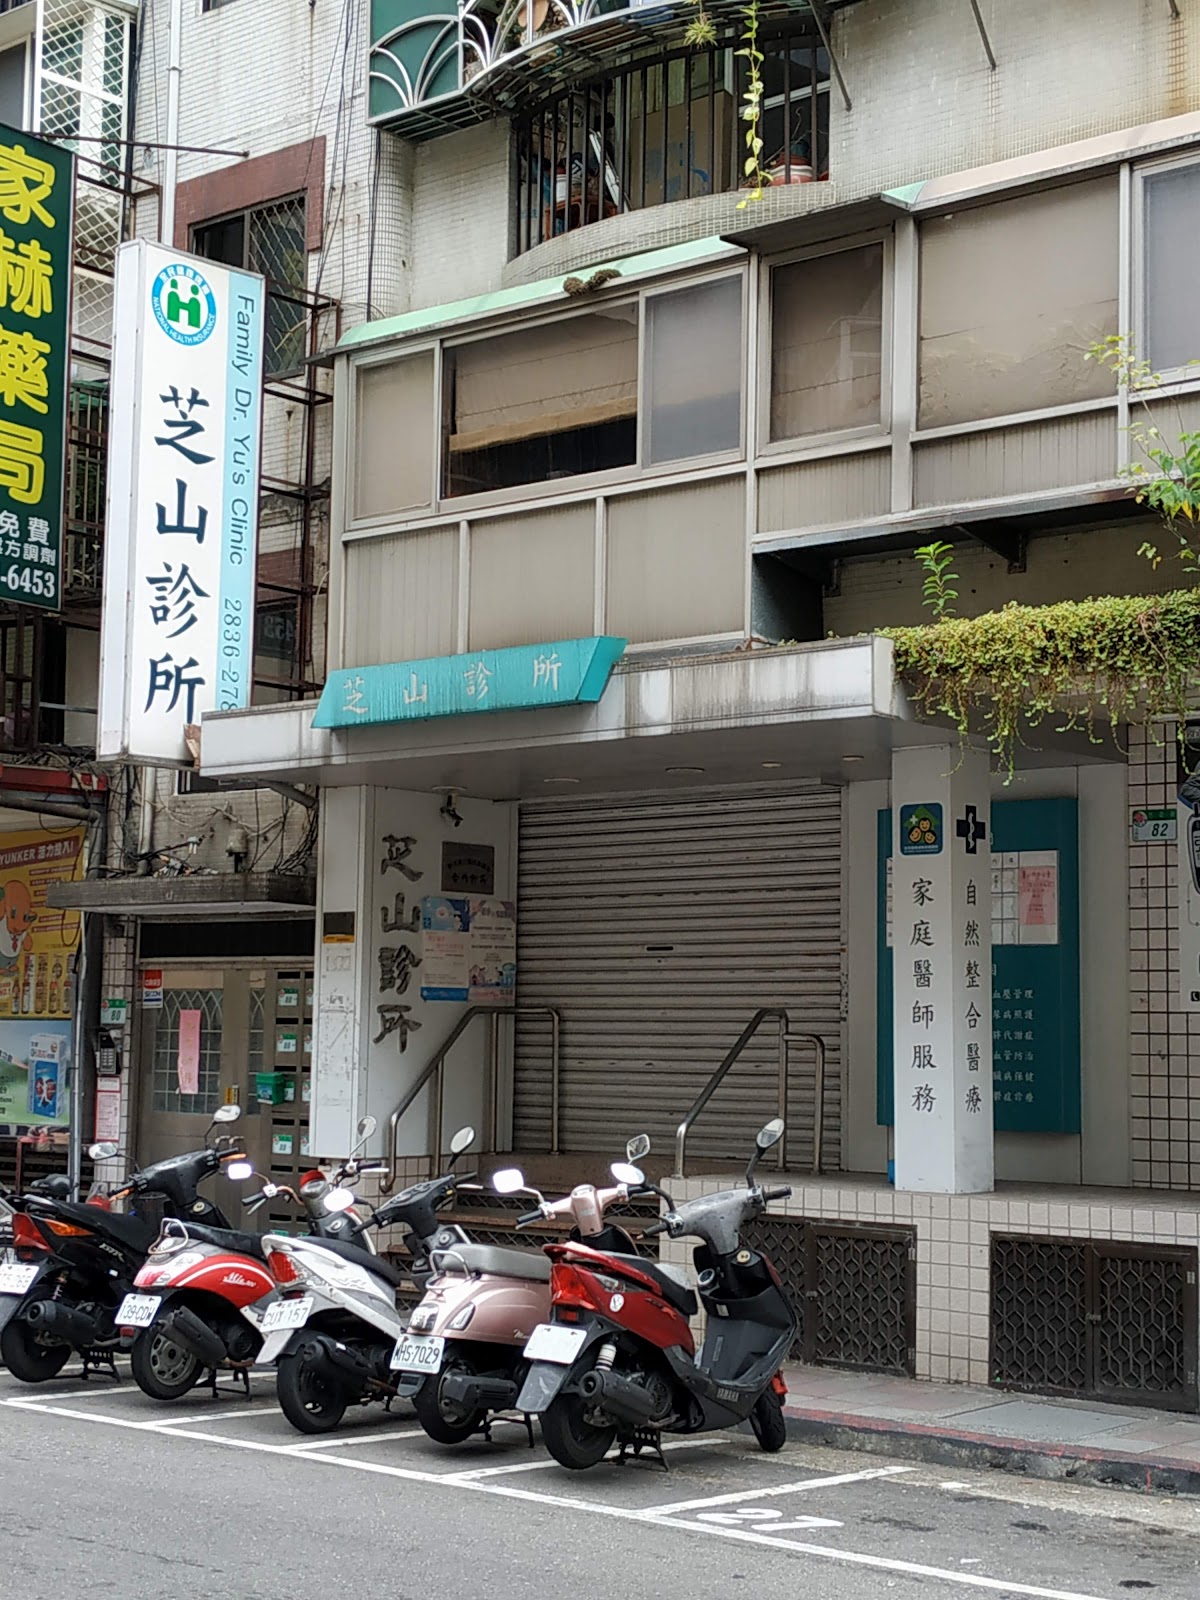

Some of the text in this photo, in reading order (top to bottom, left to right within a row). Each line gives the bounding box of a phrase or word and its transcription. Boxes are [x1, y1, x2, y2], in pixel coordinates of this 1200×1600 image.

[232, 294, 255, 377] Family
[232, 387, 252, 421] Dr.
[232, 434, 251, 486] Yu's
[0, 510, 50, 546] 免費
[0, 537, 57, 567] 方調劑
[143, 384, 215, 723] 芝山診所
[229, 498, 248, 566] Clinic
[342, 653, 562, 715] 芝山診所
[1151, 822, 1169, 837] 82
[373, 834, 423, 1054] 芝山診所
[909, 878, 937, 1114] 家庭醫師服務
[963, 879, 983, 1114] 自然整合醫療
